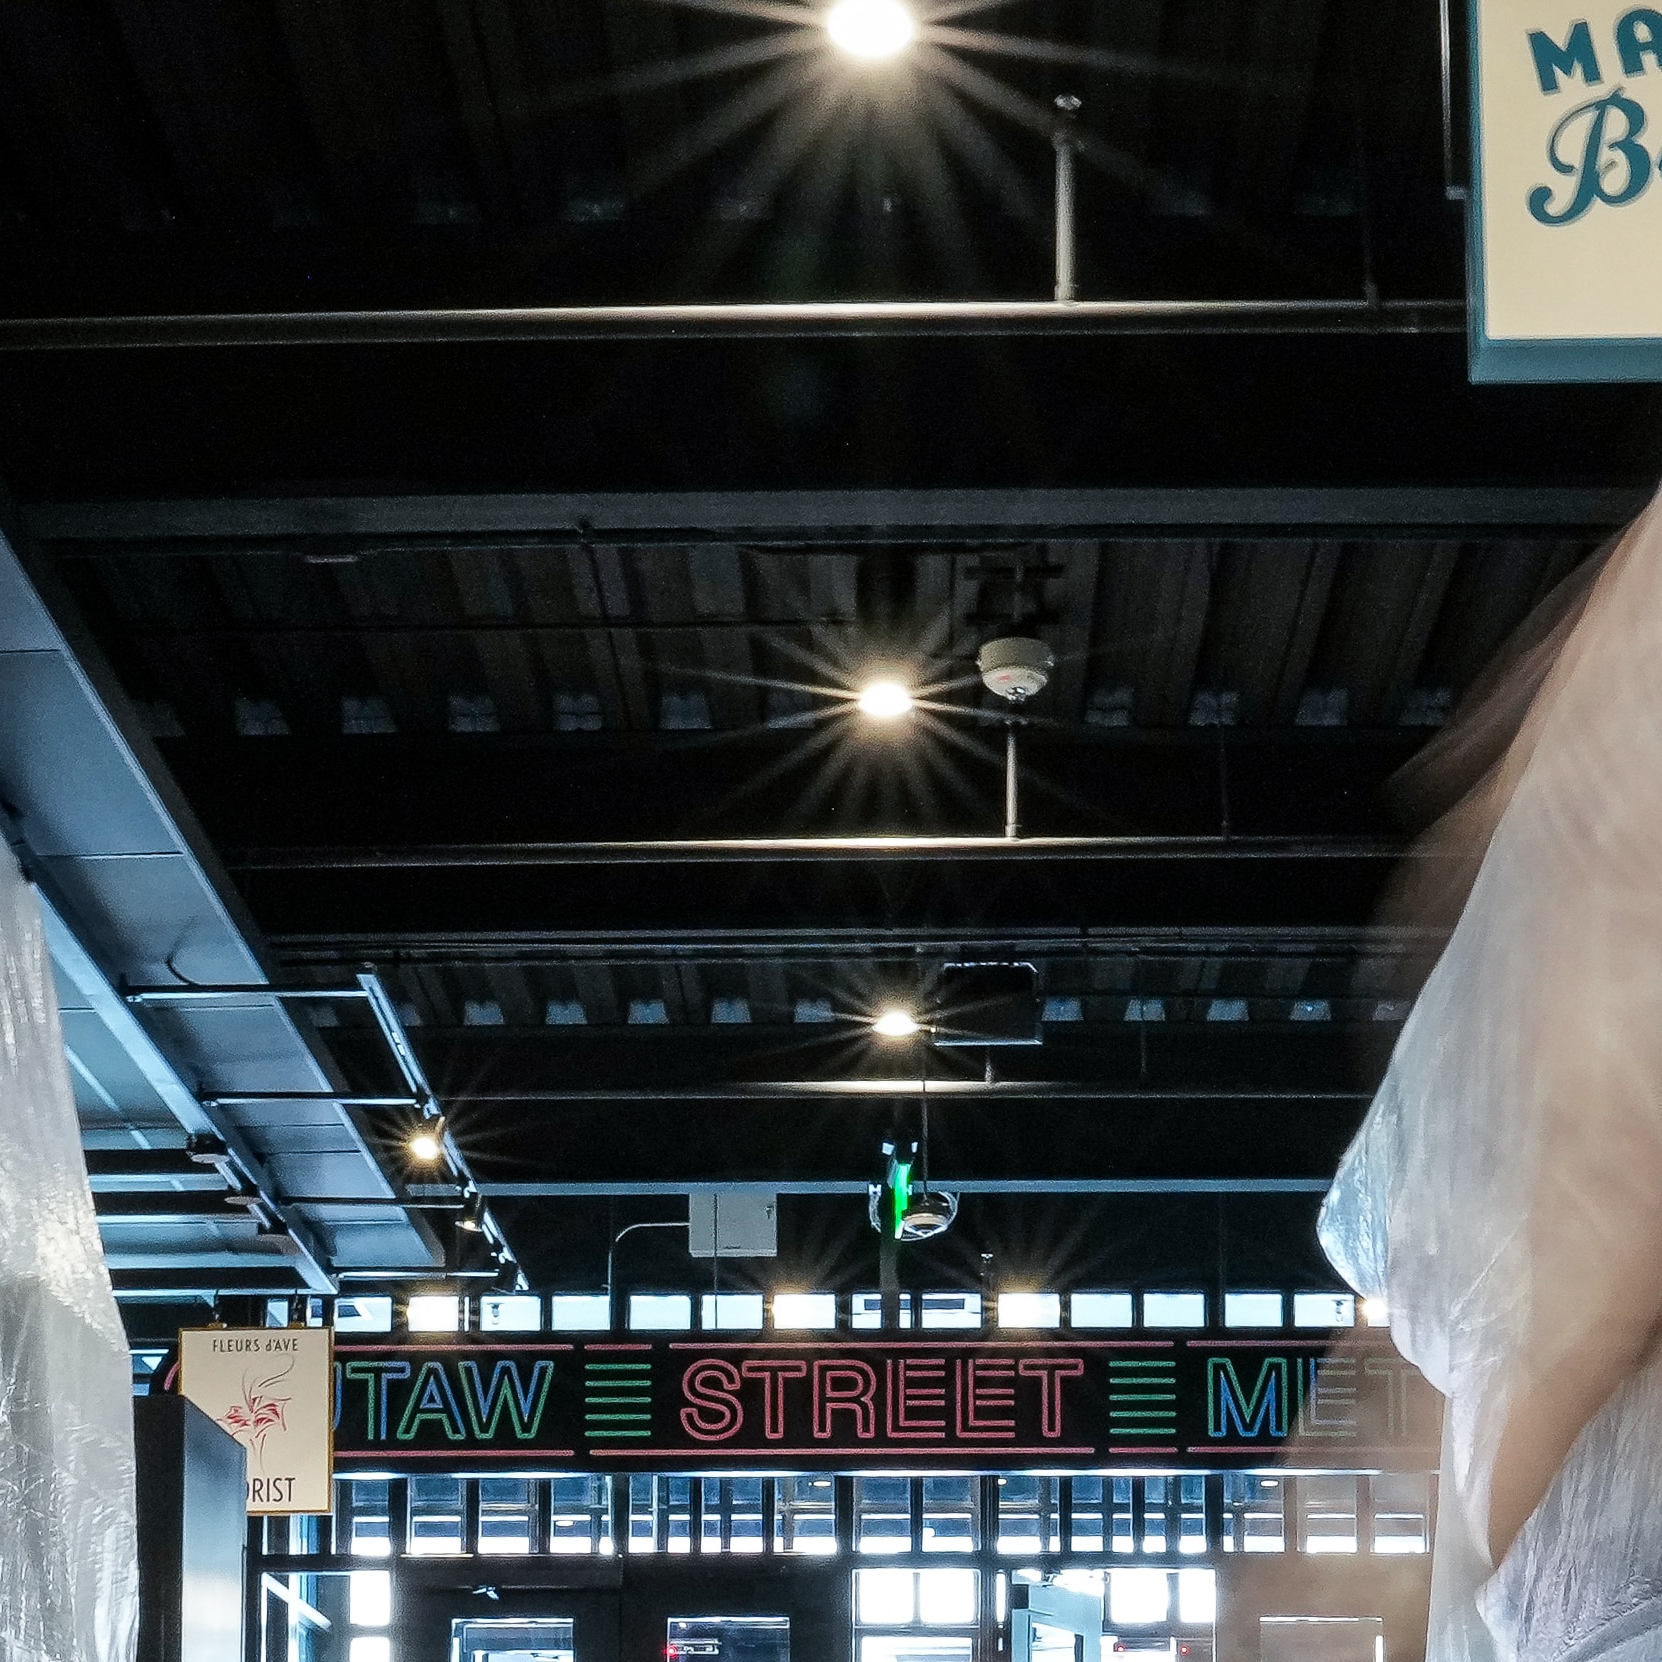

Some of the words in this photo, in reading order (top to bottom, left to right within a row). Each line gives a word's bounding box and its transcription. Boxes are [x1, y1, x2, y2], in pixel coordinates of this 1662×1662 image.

[211, 1338, 261, 1354] FLEURS
[264, 1337, 299, 1353] d'AVE
[679, 1357, 1086, 1442] STREET
[246, 1476, 297, 1504] RIST
